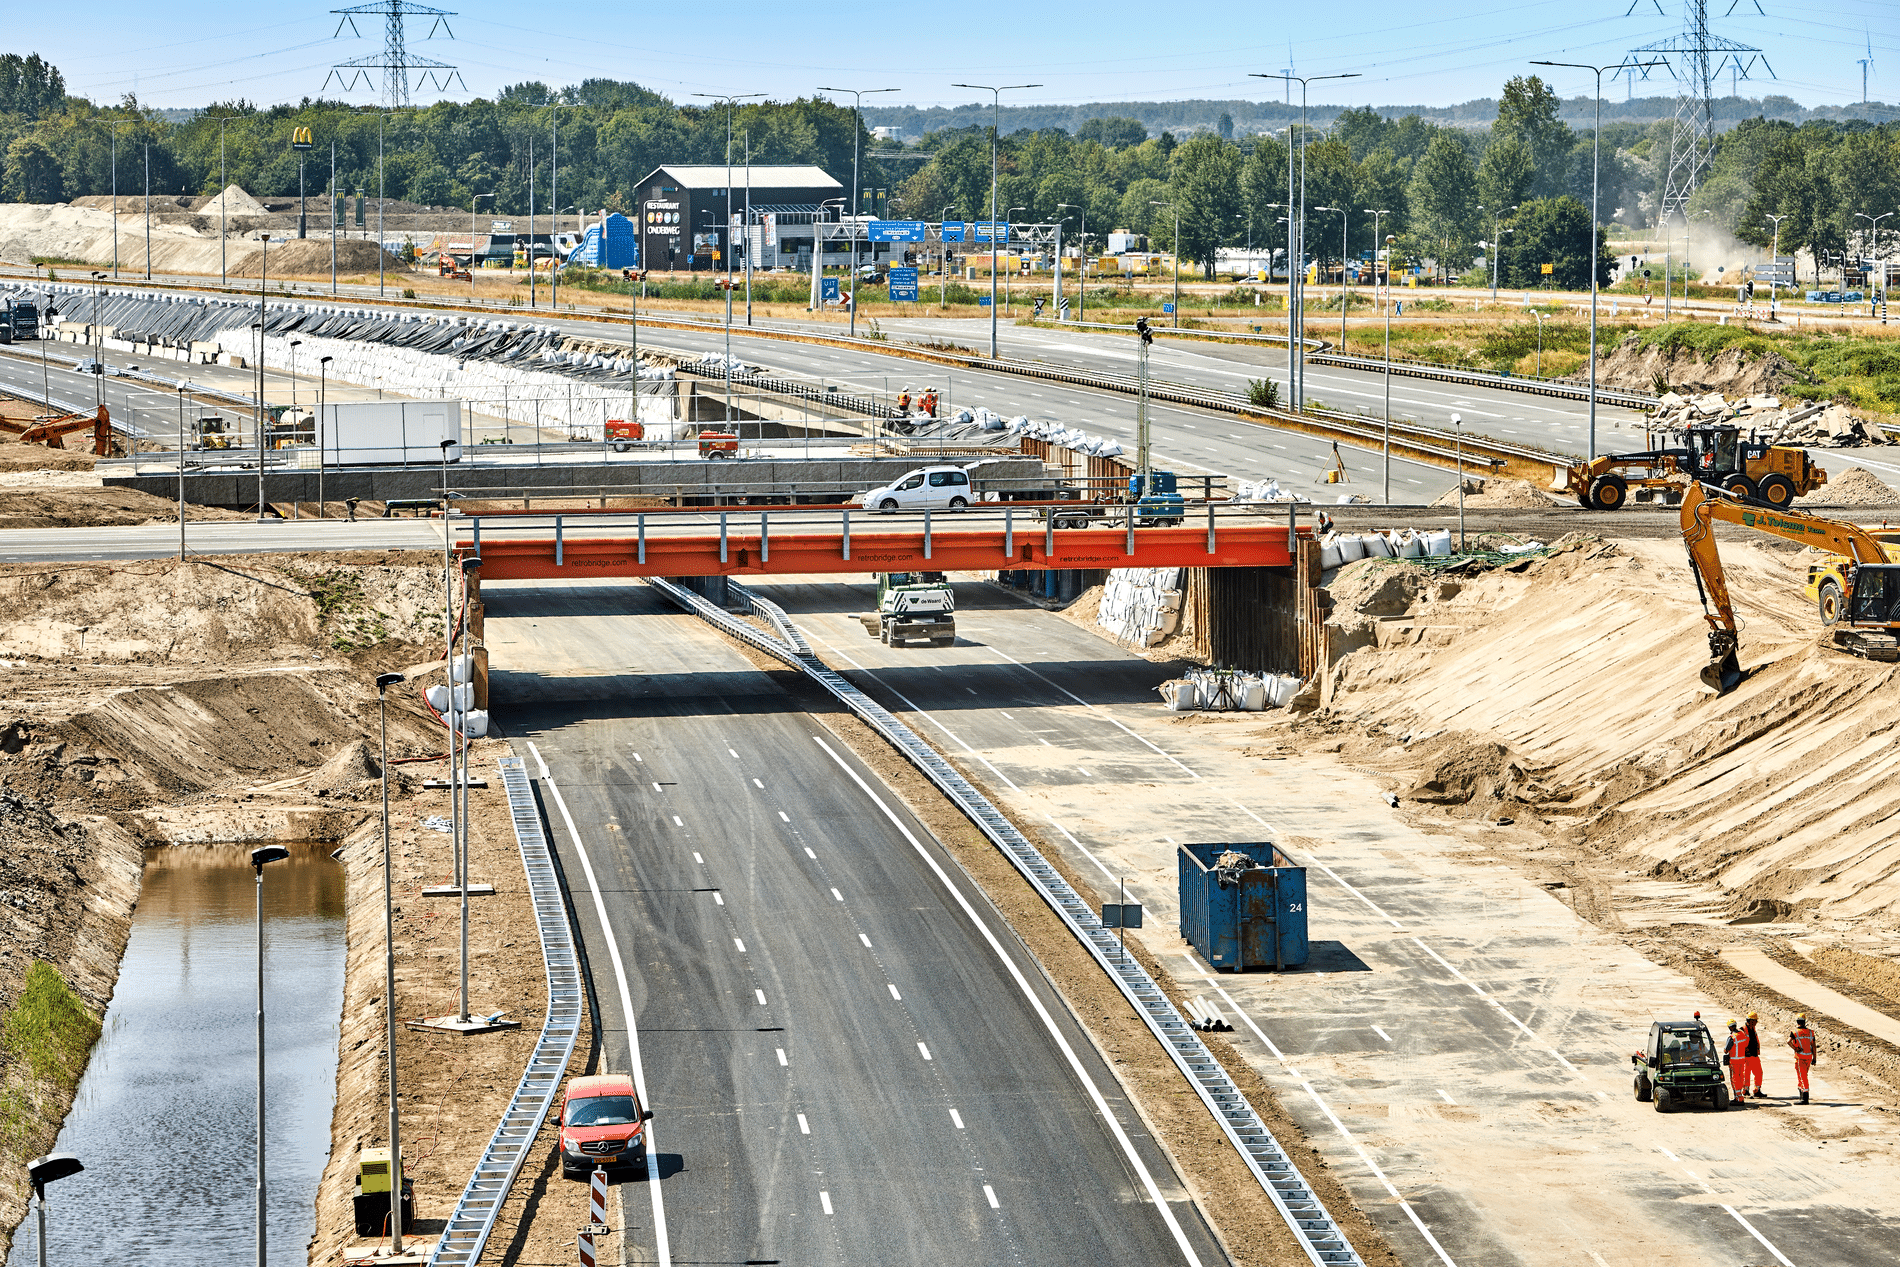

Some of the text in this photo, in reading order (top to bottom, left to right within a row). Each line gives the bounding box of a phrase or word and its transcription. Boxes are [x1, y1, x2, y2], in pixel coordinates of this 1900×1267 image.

[646, 202, 680, 210] RESTAURANT
[647, 225, 680, 235] ONDERWEG
[53, 424, 79, 434] HYUNDAI
[1747, 450, 1762, 460] CAT
[1767, 516, 1805, 531] Tolsma
[571, 558, 628, 568] retrobridge.com
[857, 553, 914, 563] retrobridge.com
[1059, 555, 1119, 563] retrobridge.com
[1289, 902, 1303, 913] 24
